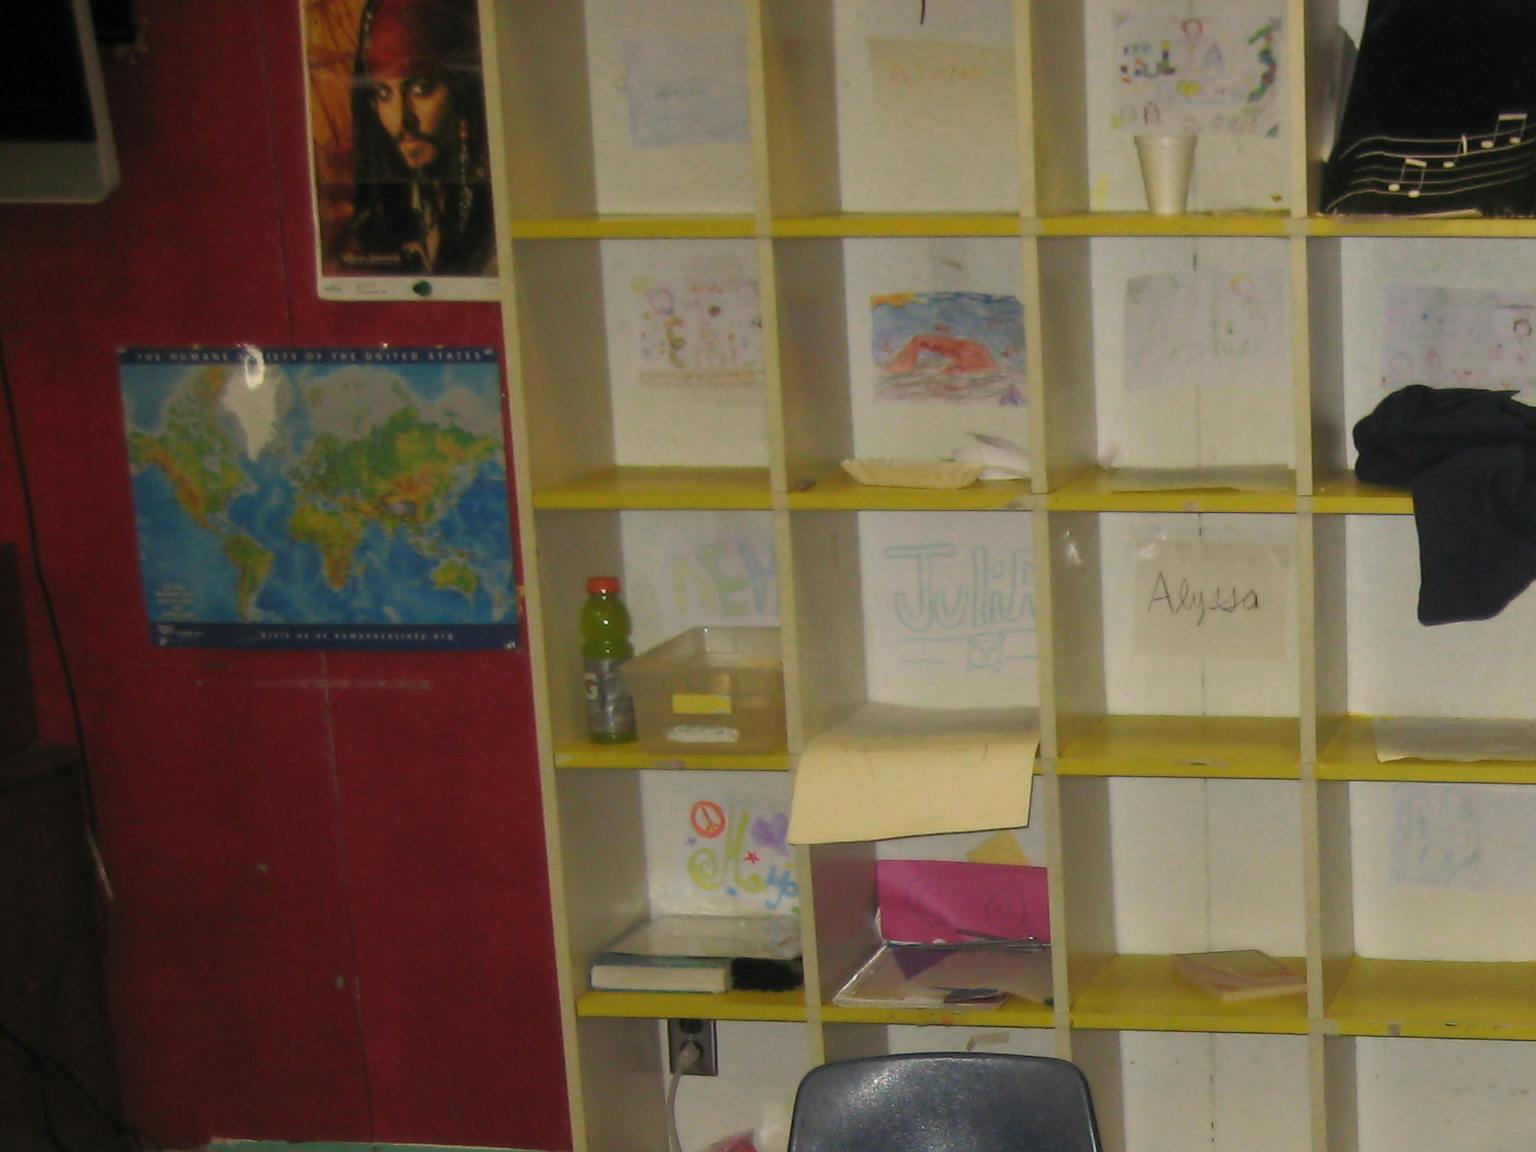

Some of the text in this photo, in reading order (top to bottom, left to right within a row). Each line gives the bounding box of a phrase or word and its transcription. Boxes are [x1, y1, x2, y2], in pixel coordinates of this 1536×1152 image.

[331, 352, 357, 361] THE
[365, 352, 419, 361] UNITED
[428, 351, 481, 361] STATES
[1147, 570, 1259, 626] Alyssa
